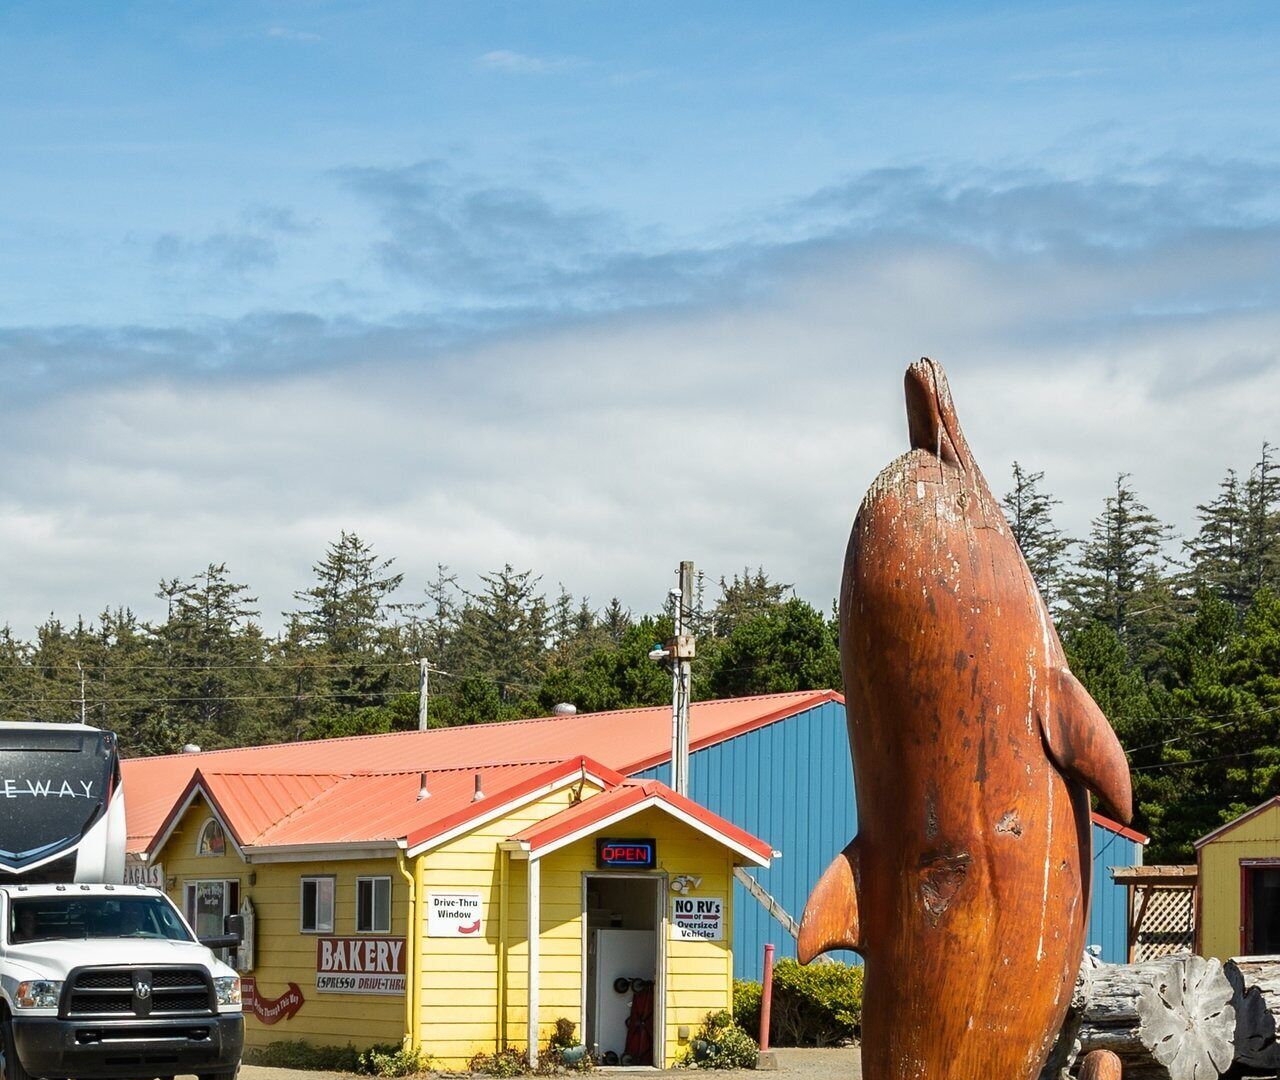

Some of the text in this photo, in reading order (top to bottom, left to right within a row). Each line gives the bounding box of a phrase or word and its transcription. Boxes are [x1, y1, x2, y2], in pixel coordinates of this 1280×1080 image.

[601, 847, 647, 861] OPEN
[434, 898, 478, 907] Drive-Thru
[675, 900, 720, 913] NO RV's
[438, 910, 471, 918] Window
[677, 921, 718, 929] Oversized
[681, 929, 715, 938] Vehicles
[321, 940, 403, 972] BAKERY
[317, 976, 356, 989] ESPRESSO
